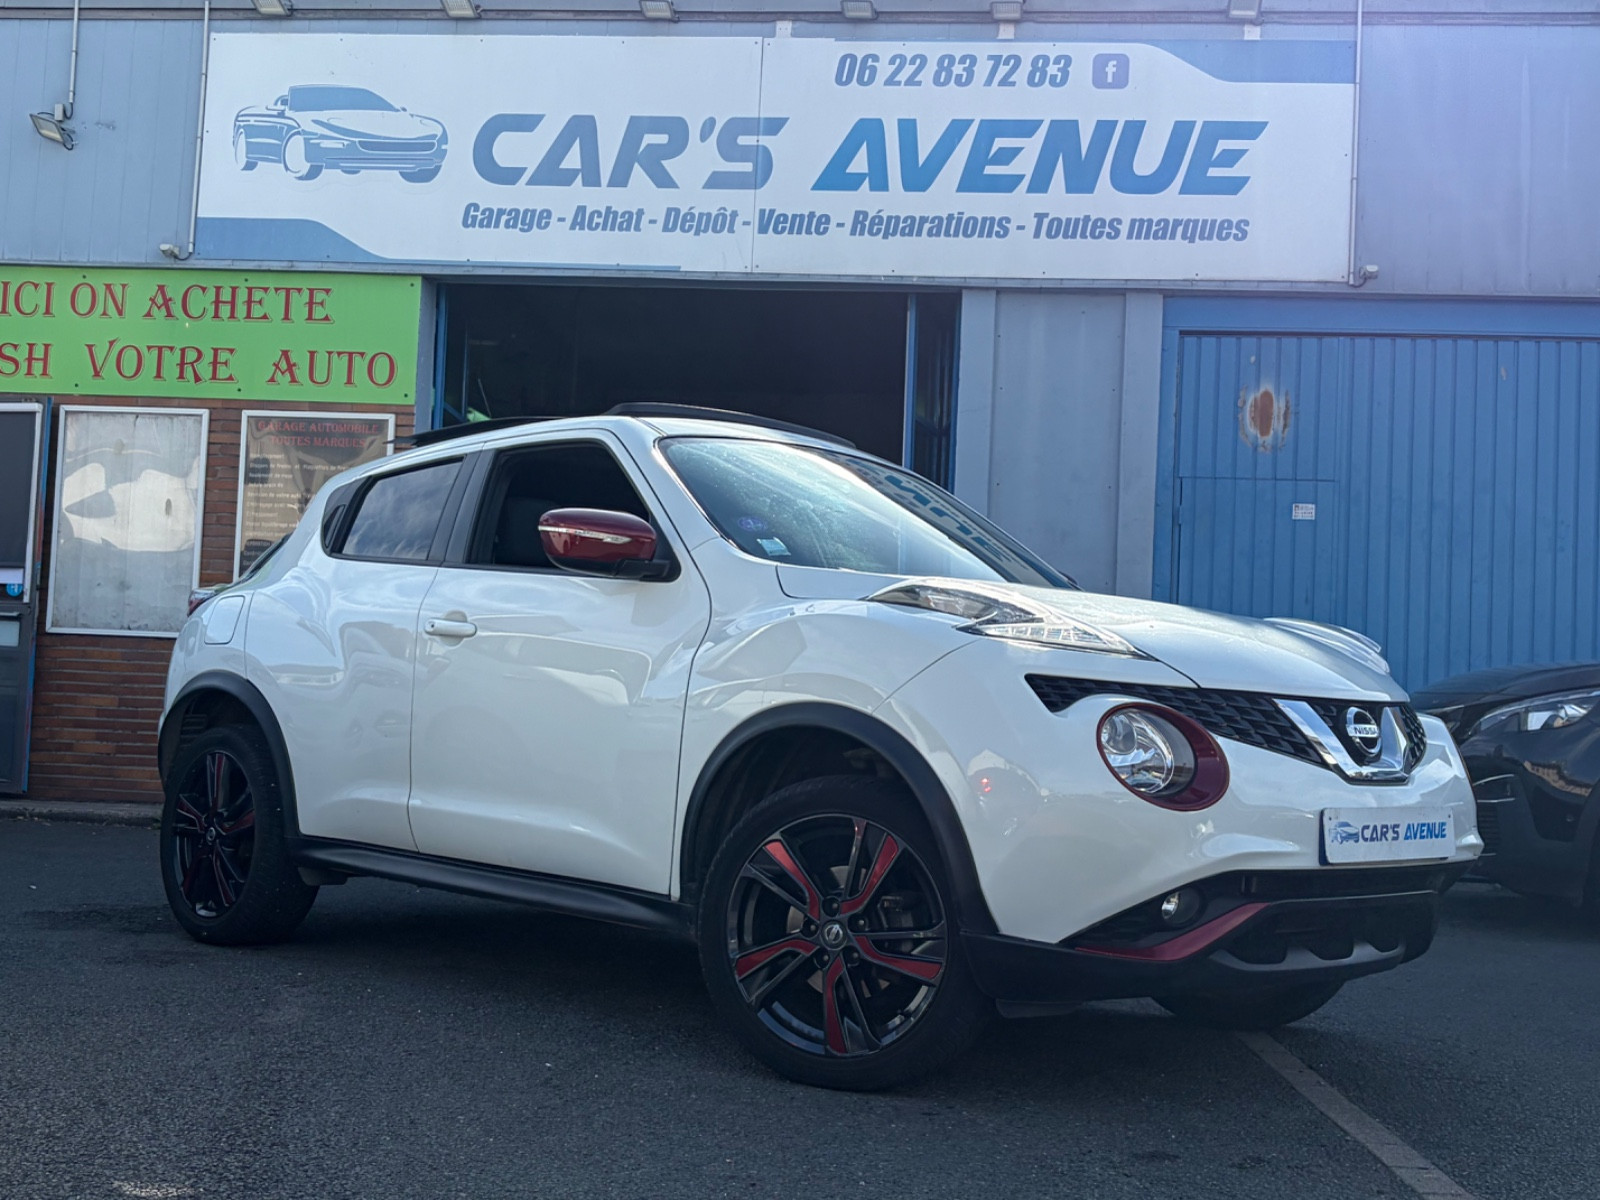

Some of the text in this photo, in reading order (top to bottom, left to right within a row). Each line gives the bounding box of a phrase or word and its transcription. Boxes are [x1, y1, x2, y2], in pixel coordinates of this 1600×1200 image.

[834, 53, 1072, 88] 06 22 83 72 83
[473, 113, 1269, 196] CAR'S AVENUE
[461, 202, 553, 233] Garage
[569, 205, 645, 232] Achat
[662, 206, 740, 236] Dépôt
[757, 208, 831, 236] Vente
[849, 208, 1011, 240] Réparations
[1032, 212, 1123, 241] Toutes
[1126, 216, 1250, 243] marques
[0, 281, 334, 324] ICI ON ACHETE
[84, 337, 239, 385] VOTRE
[266, 349, 398, 388] AUTO
[258, 421, 379, 434] GARAGE AUTOMOBILE
[271, 435, 366, 448] TOUTES MARQUES
[1354, 726, 1377, 735] NISS
[1361, 822, 1447, 842] CAR'S AVENUE
